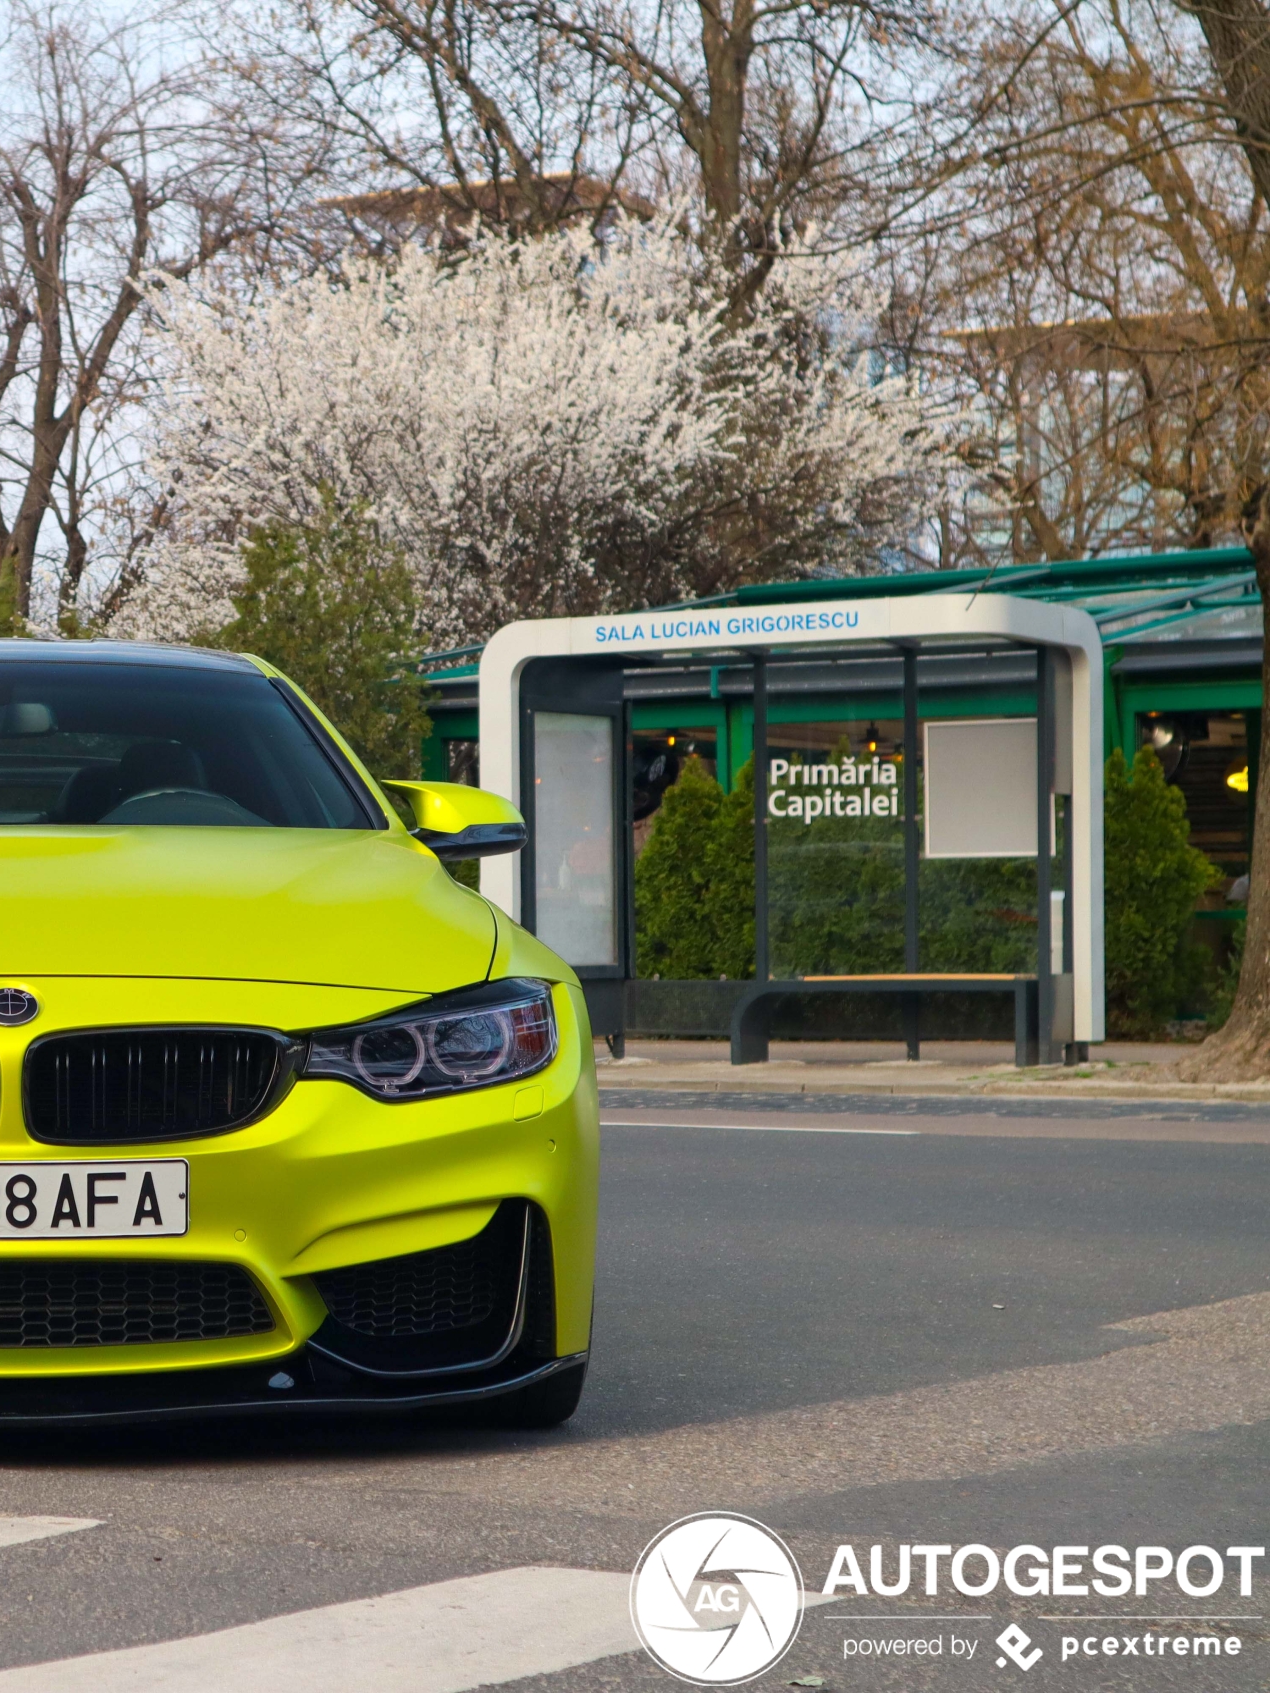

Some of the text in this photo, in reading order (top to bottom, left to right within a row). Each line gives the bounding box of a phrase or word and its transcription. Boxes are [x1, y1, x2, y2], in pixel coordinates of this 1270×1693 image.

[596, 611, 860, 643] SALA LUCIAN GRIGORESCU
[768, 787, 899, 825] Capitalei
